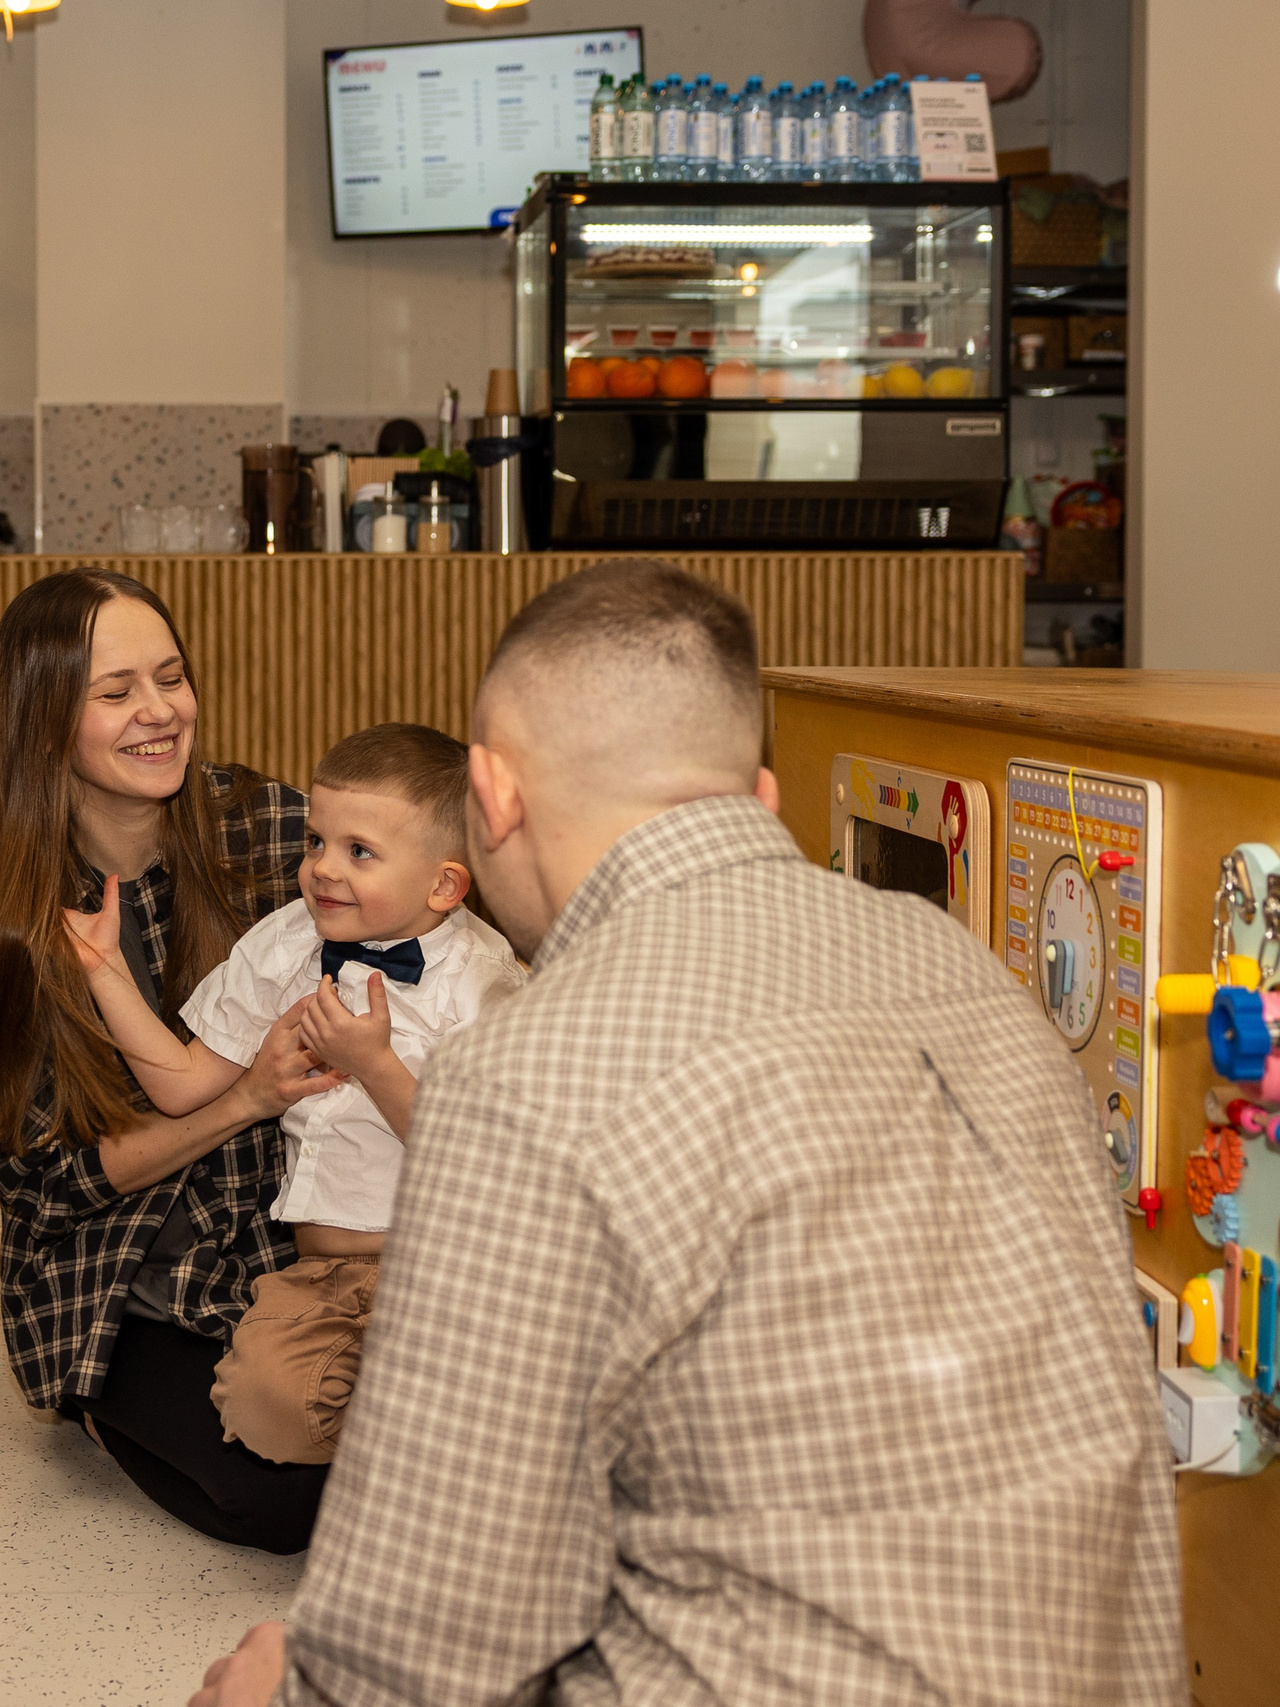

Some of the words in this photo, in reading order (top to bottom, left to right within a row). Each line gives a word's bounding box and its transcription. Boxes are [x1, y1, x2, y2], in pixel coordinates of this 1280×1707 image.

[1052, 815, 1059, 827] 22
[1060, 816, 1067, 829] 23
[1055, 883, 1062, 906] 11
[1065, 877, 1075, 900] 12
[1079, 889, 1083, 913] 1
[1047, 909, 1056, 930] 10
[1087, 912, 1093, 934] 2
[1089, 946, 1096, 969] 3
[1086, 980, 1093, 1003] 4
[1067, 1005, 1074, 1029] 6
[1079, 1002, 1085, 1026] 5
